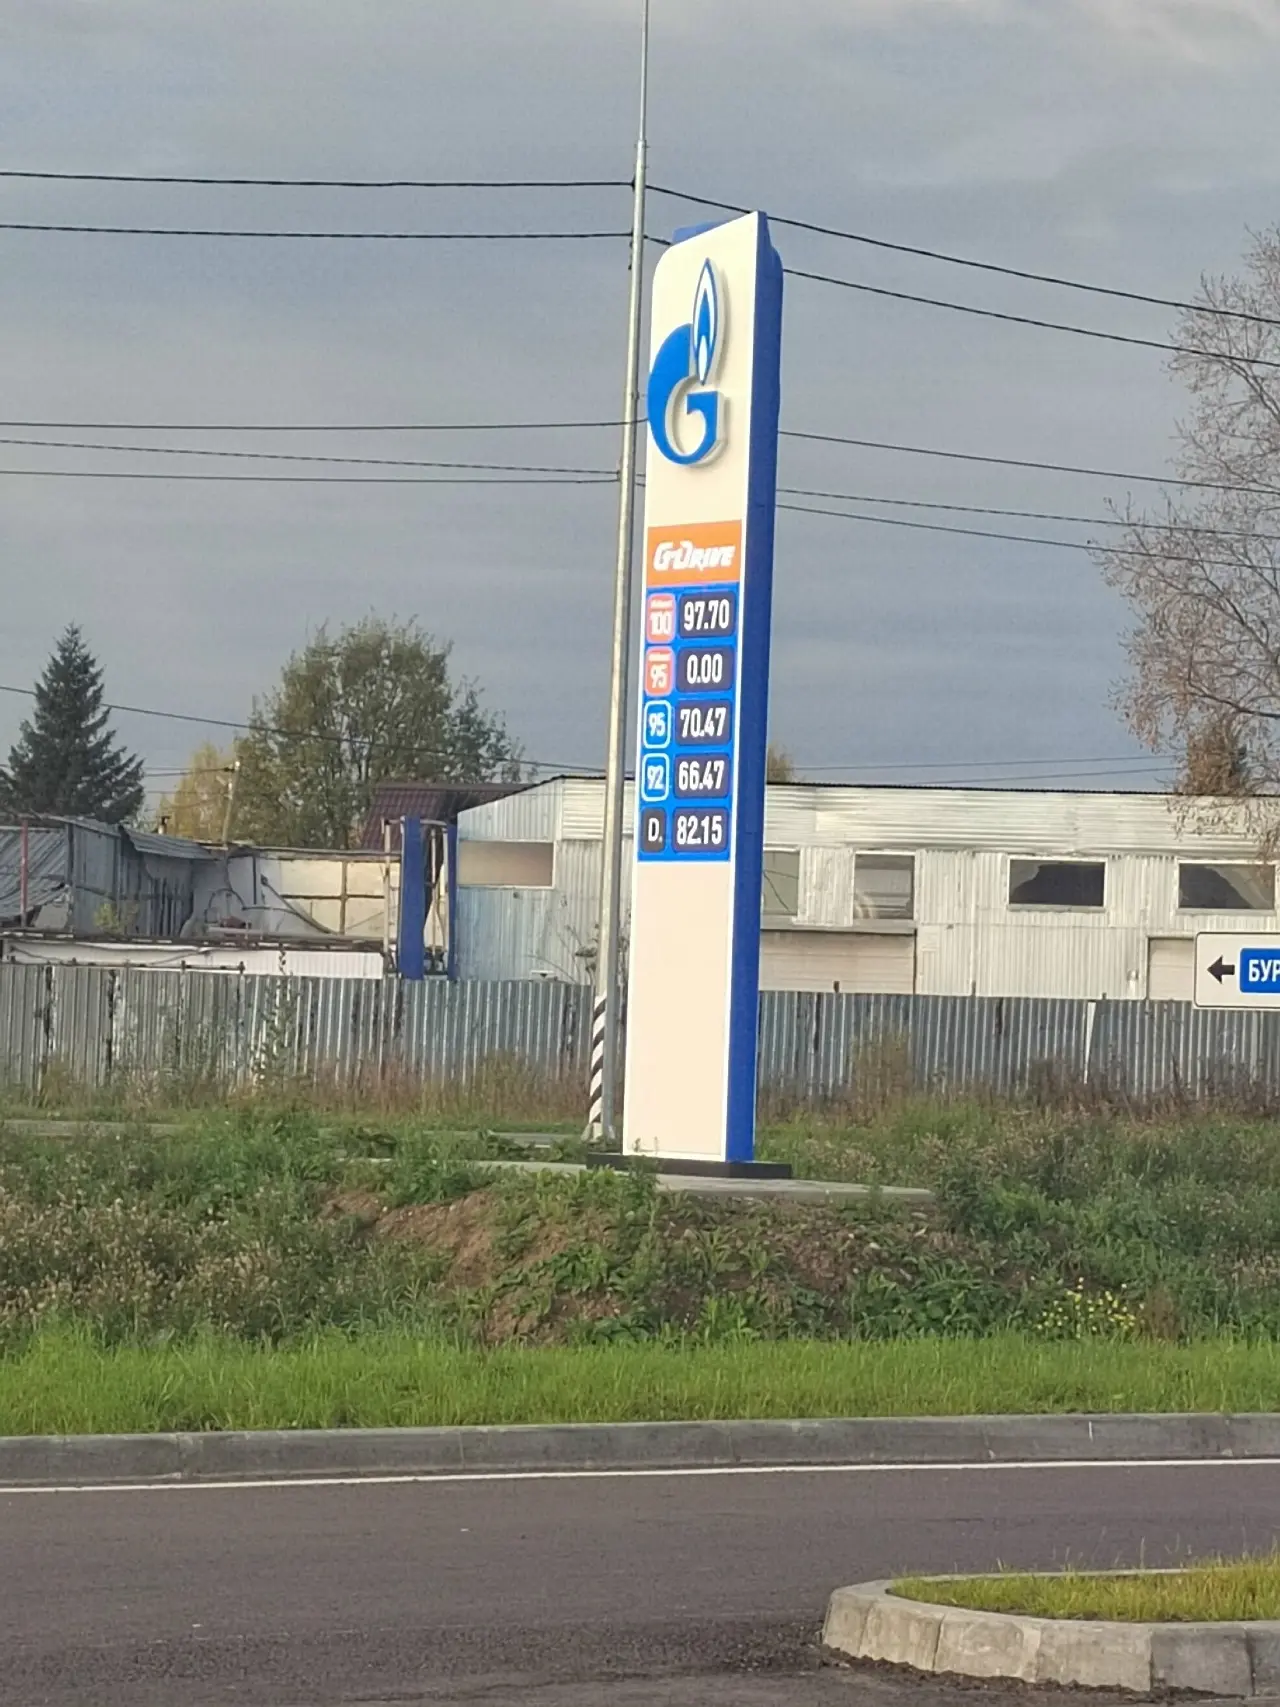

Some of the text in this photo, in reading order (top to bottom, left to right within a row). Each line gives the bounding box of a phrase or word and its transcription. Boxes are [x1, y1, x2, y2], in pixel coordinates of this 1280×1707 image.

[683, 598, 730, 631] 97.70
[650, 653, 723, 689] 95 0.00
[649, 707, 727, 738] 95 70.47
[646, 760, 725, 791] 92 66.47
[676, 815, 723, 845] 82.15
